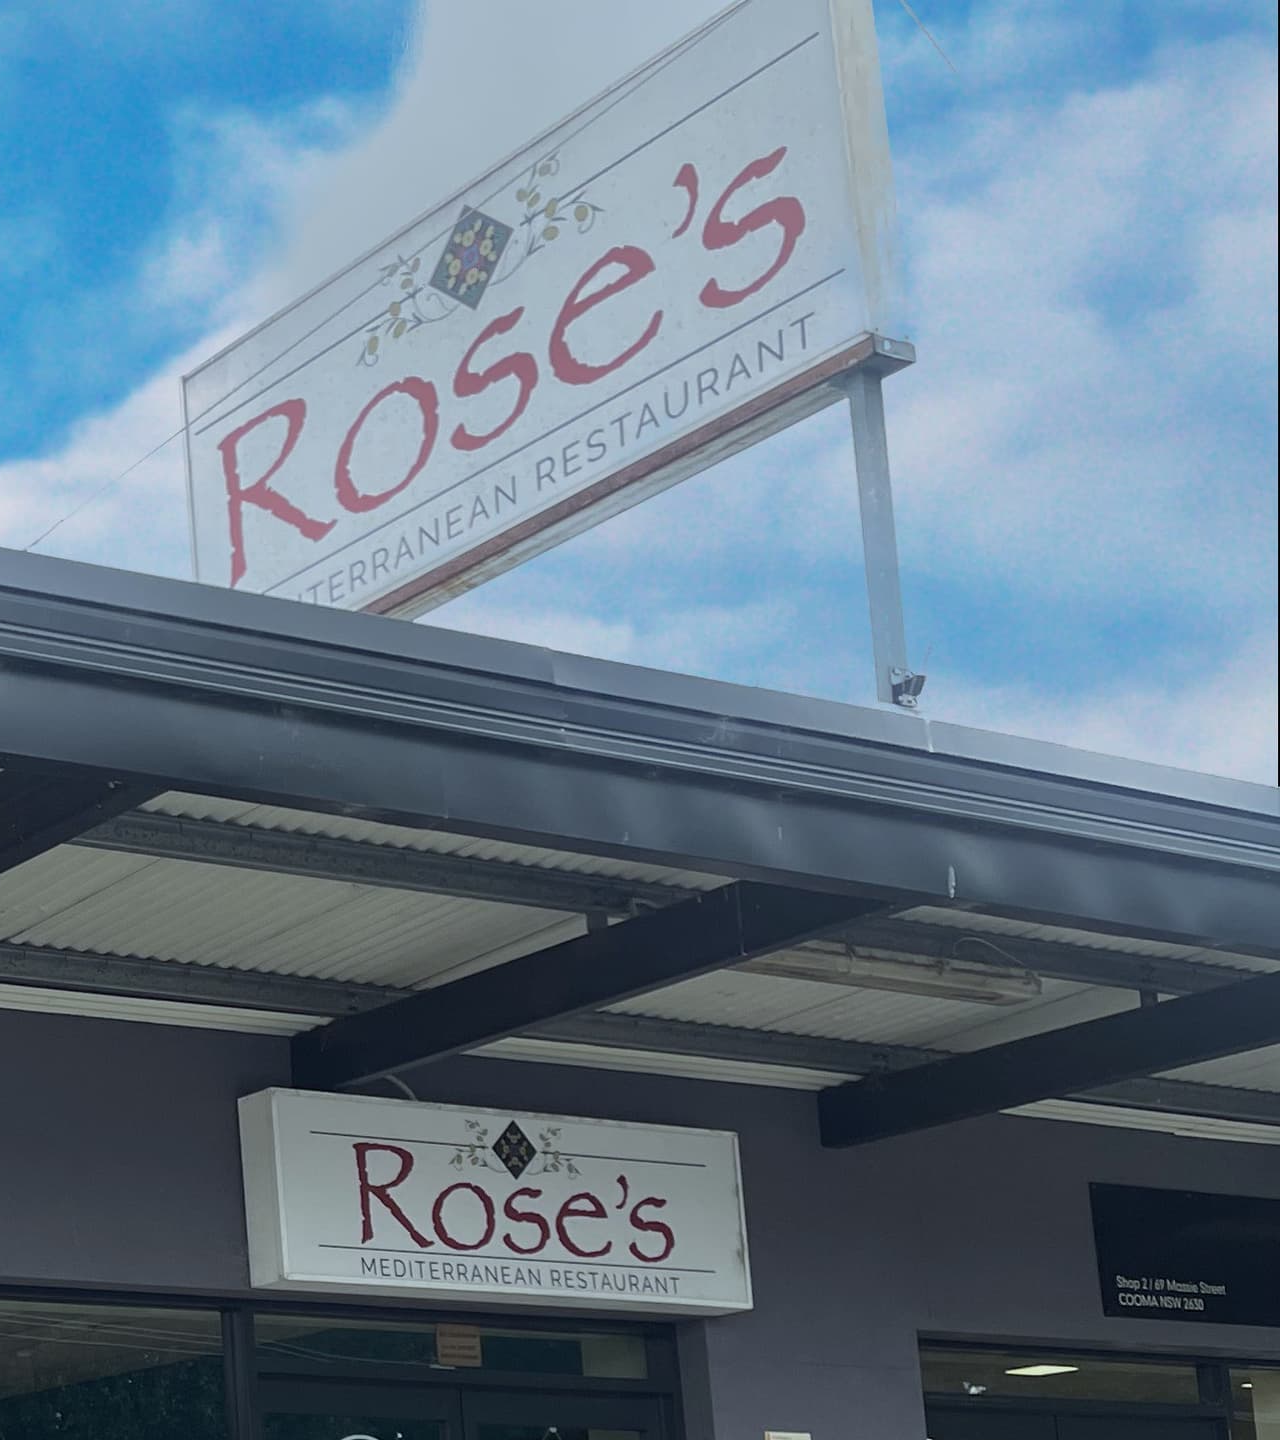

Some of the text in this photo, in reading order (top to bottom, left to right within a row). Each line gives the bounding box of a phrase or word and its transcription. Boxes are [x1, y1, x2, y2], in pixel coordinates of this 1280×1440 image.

[217, 146, 807, 588] Rose's
[296, 312, 815, 605] TERRANEAN RESTAURANT
[352, 1141, 676, 1264] Rose's
[361, 1256, 680, 1295] MEDITERRANEAN RESTAURANT
[1116, 1275, 1140, 1290] Shop
[1141, 1277, 1147, 1290] 2
[1199, 1281, 1226, 1295] Street
[1118, 1292, 1204, 1311] COOMA NSW 2630
